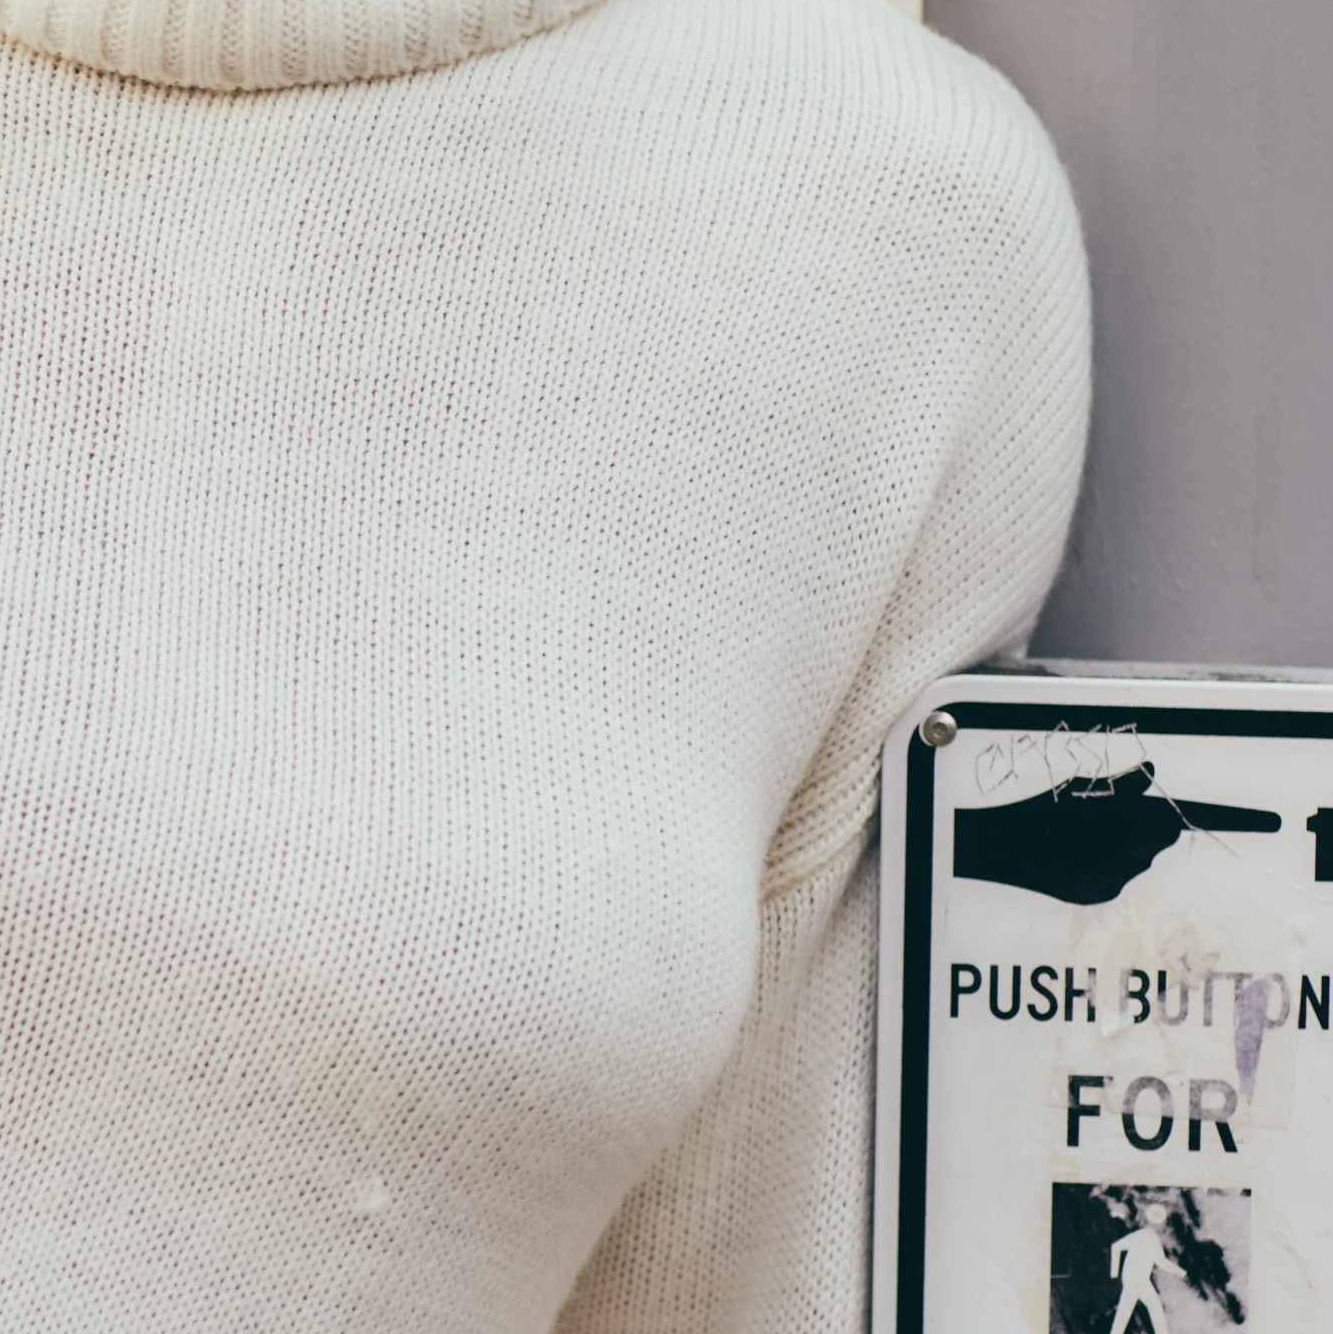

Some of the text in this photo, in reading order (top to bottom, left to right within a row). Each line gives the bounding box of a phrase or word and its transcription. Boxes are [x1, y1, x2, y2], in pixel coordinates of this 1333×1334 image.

[950, 963, 1330, 1030] PUSH BUTTON
[1067, 1075, 1238, 1152] FOR
